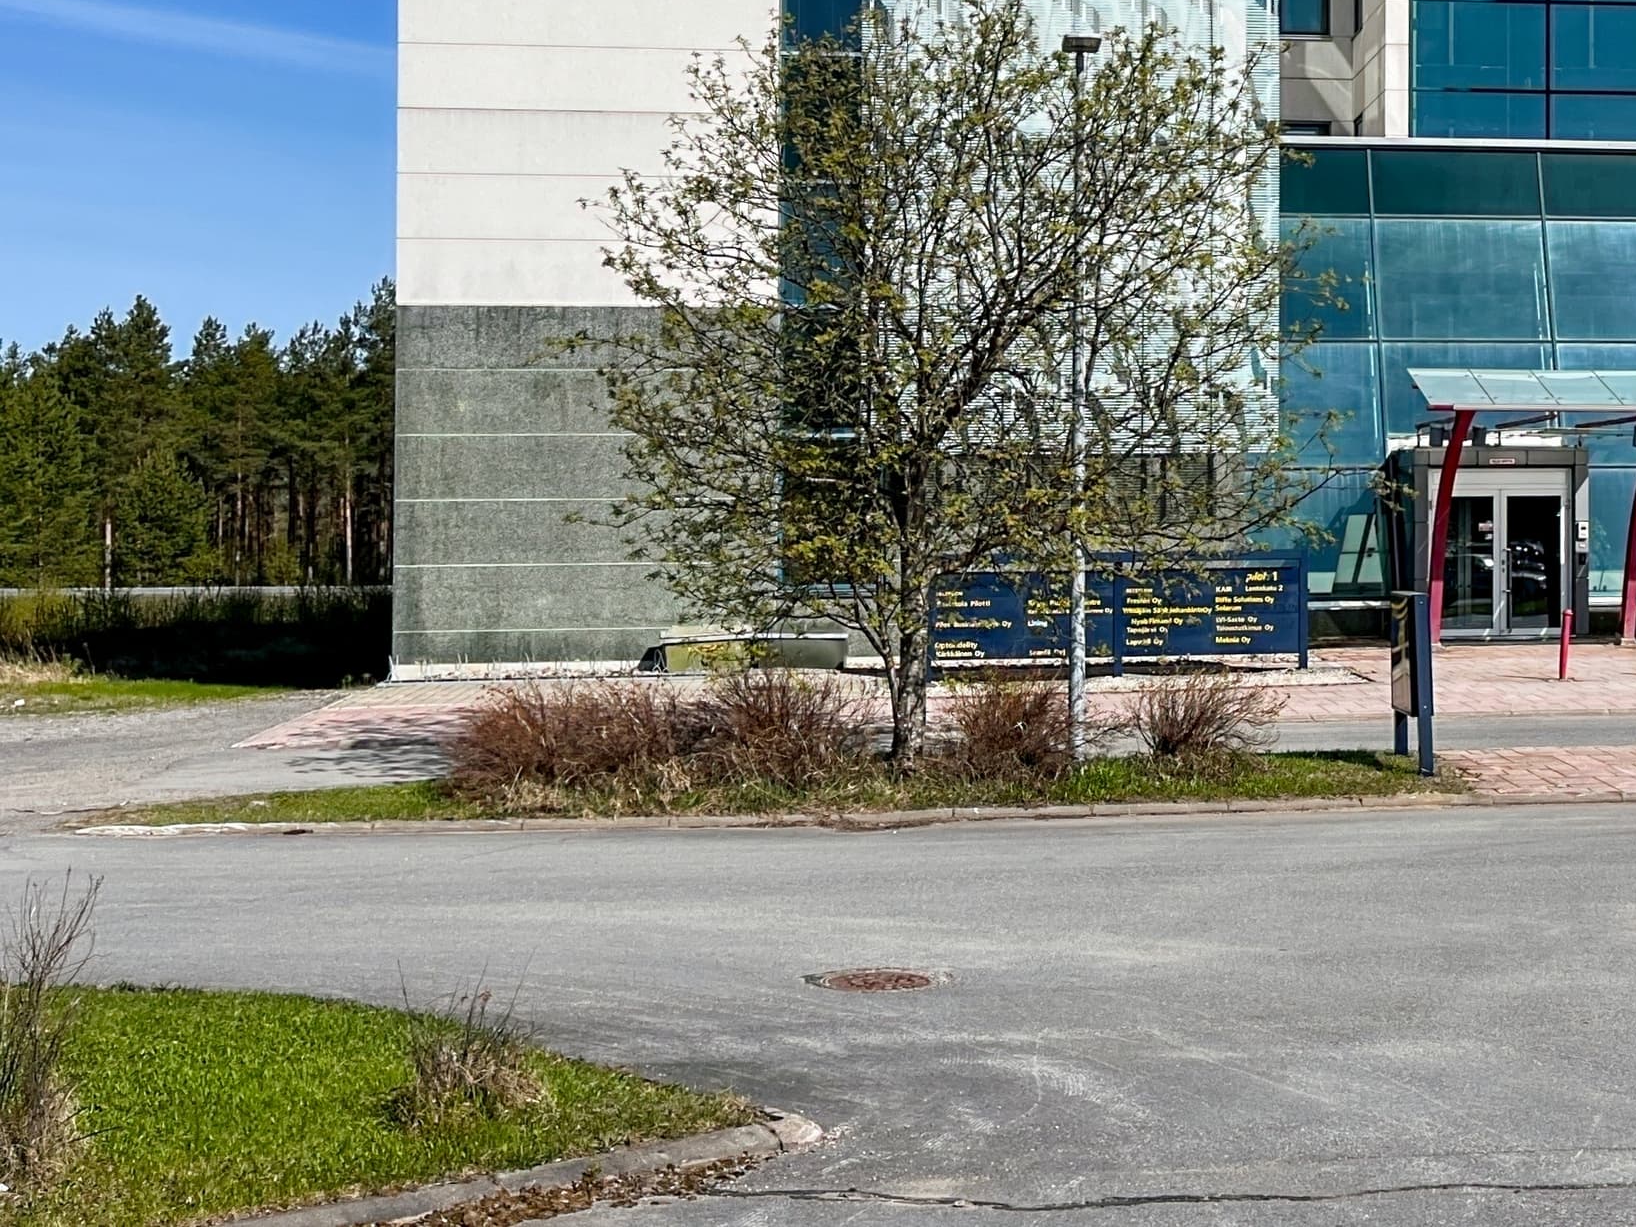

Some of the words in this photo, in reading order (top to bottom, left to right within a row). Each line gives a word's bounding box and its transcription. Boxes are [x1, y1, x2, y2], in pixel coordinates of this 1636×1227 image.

[1272, 571, 1278, 581] 1
[1151, 597, 1162, 605] Oy
[1264, 596, 1275, 604] Oy
[1001, 621, 1012, 629] Oy
[1173, 617, 1184, 626] Oy
[1264, 624, 1274, 632] Oy
[1153, 638, 1164, 646] Oy
[1241, 636, 1251, 644] Oy
[974, 650, 985, 658] Oy
